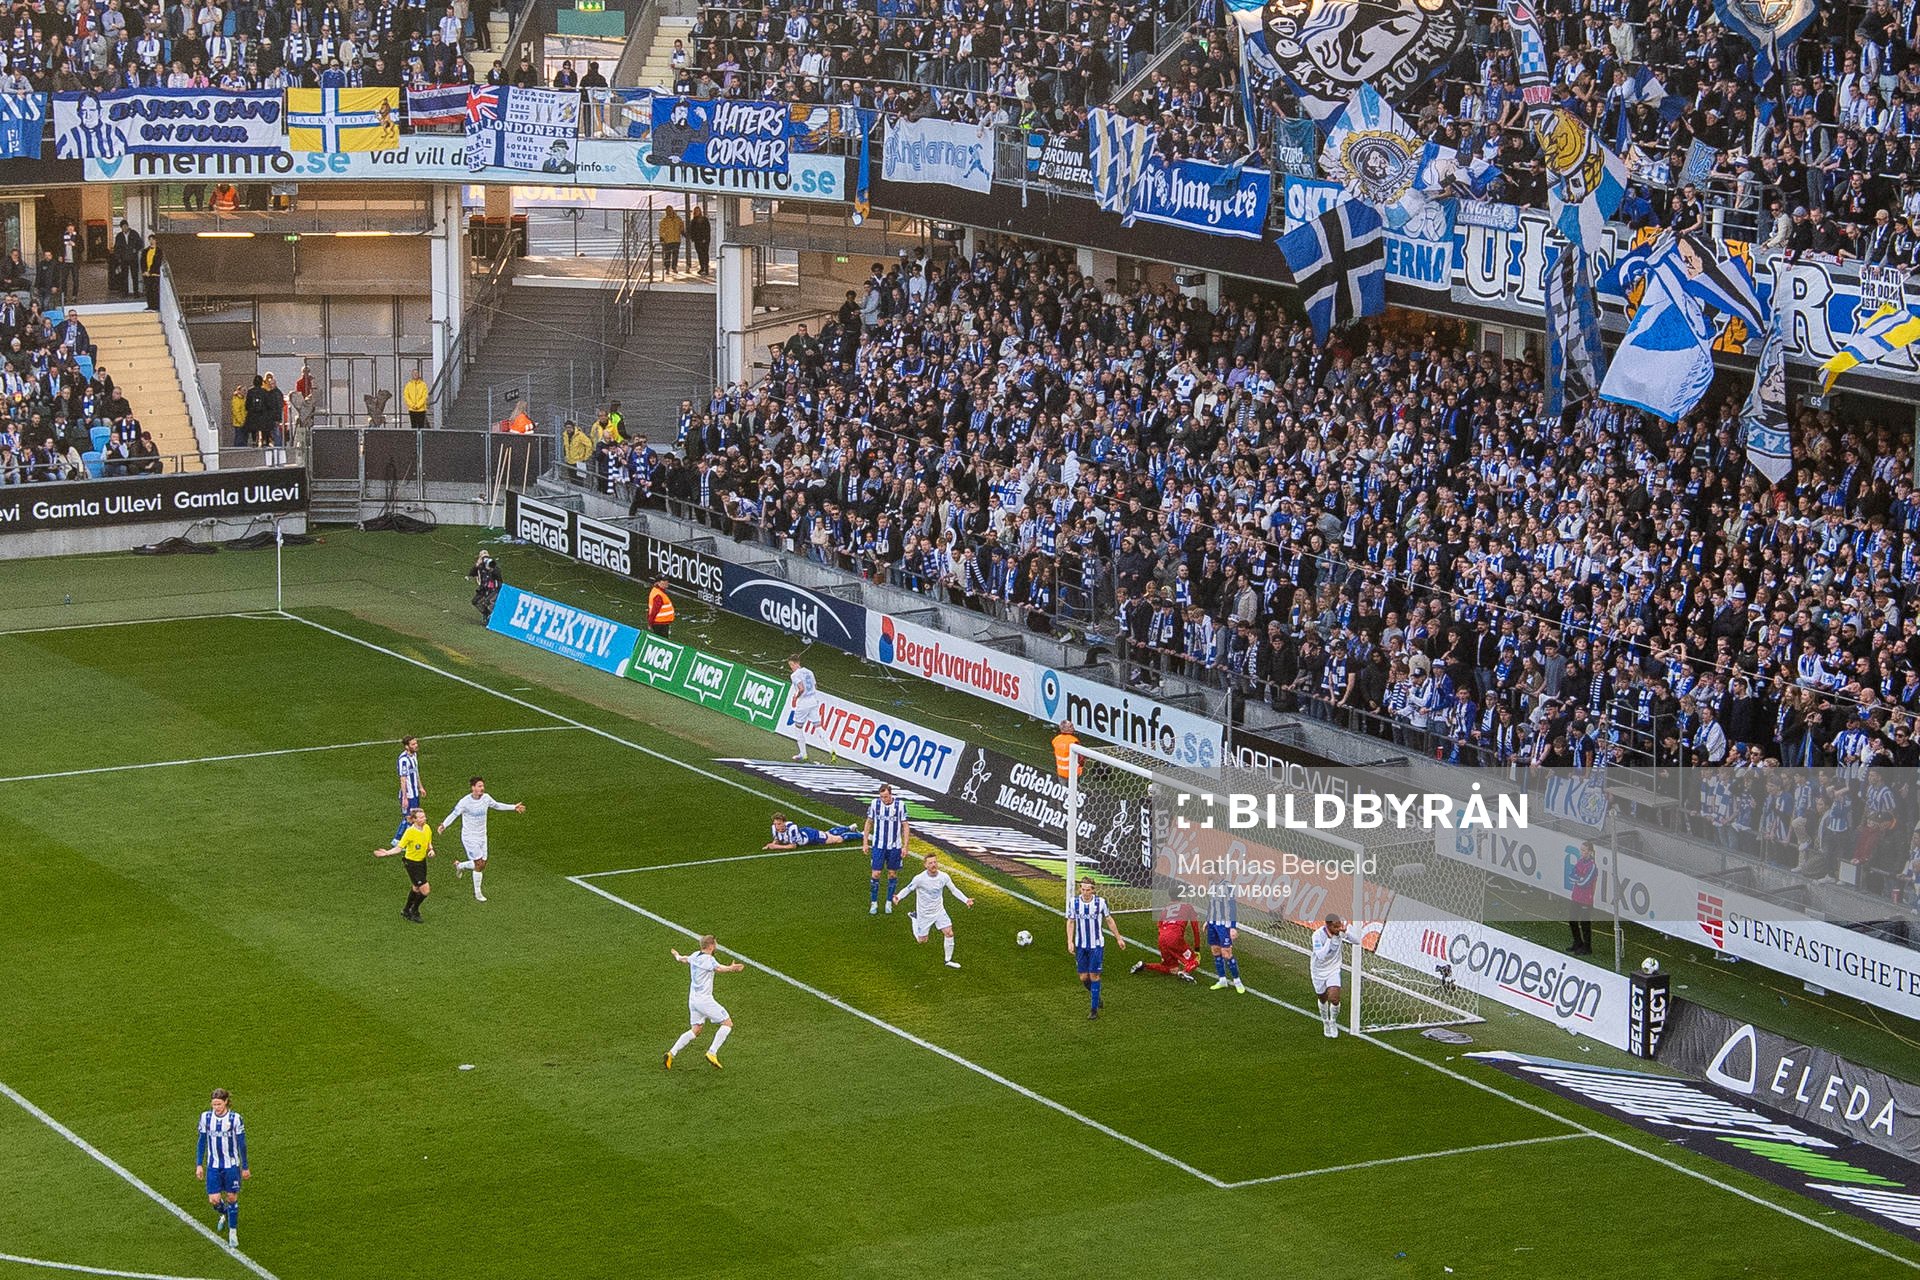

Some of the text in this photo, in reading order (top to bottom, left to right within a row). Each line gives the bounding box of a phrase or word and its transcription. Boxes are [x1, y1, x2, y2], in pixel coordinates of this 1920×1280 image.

[487, 119, 575, 138] LONDONERS
[713, 101, 786, 136] HATERS
[420, 147, 444, 165] vill
[706, 137, 786, 169] CORNER
[1042, 147, 1084, 166] BROWN
[1048, 135, 1069, 148] THE
[1038, 161, 1093, 184] BOMBERS
[32, 501, 100, 520] Gamla
[105, 493, 162, 514] Ullevi
[173, 488, 240, 509] Gamla
[243, 483, 299, 504] Ullevi
[647, 537, 723, 592] Helanders
[509, 592, 618, 657] EFFEKTIV
[760, 597, 819, 639] cuebid
[642, 645, 673, 671] MCR
[692, 662, 723, 691] MCR
[742, 679, 775, 709] MCR
[896, 633, 1020, 700] Bergkvarabuss
[1066, 690, 1215, 769] merinfo.se
[995, 784, 1097, 839] Metallparier
[1630, 983, 1644, 1057] SELECT
[1770, 1057, 1895, 1136] ELEDA
